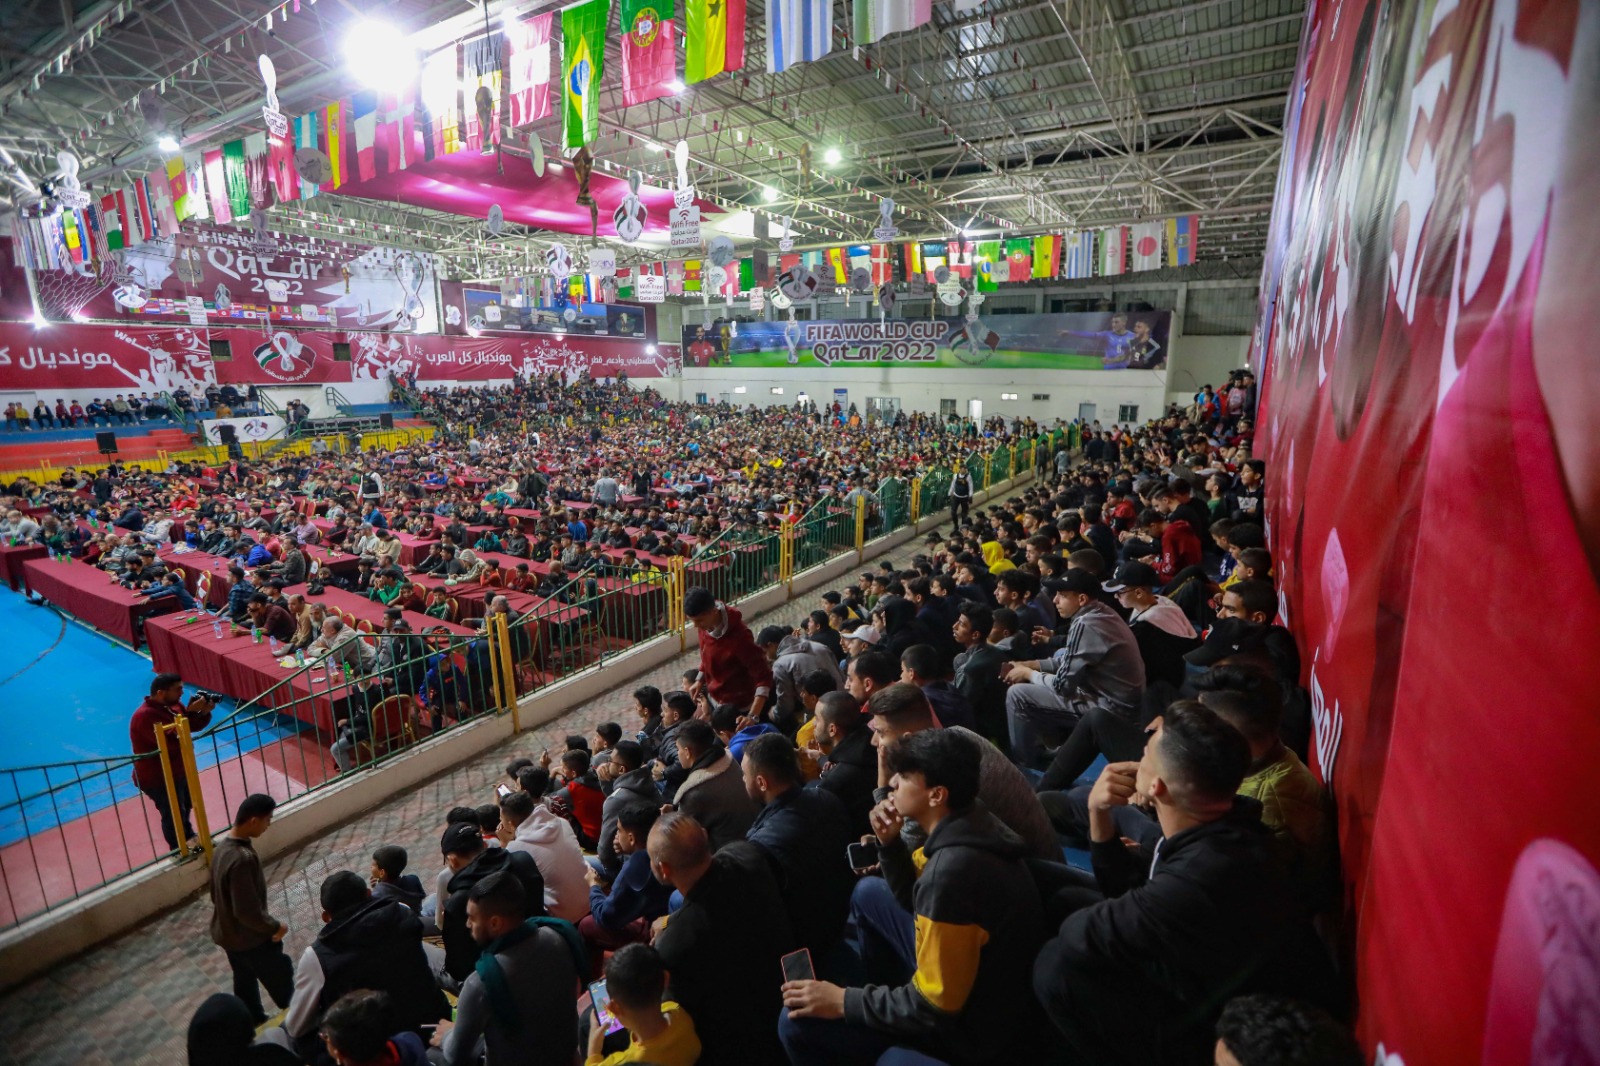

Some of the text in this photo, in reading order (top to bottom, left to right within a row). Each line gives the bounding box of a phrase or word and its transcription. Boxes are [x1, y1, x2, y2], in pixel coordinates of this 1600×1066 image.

[671, 220, 699, 229] Wifi Free
[207, 246, 323, 281] Qatar
[805, 320, 949, 342] FIFA WORLD CUP
[19, 347, 114, 370] مونديال
[425, 350, 513, 367] مونديال كل العرب
